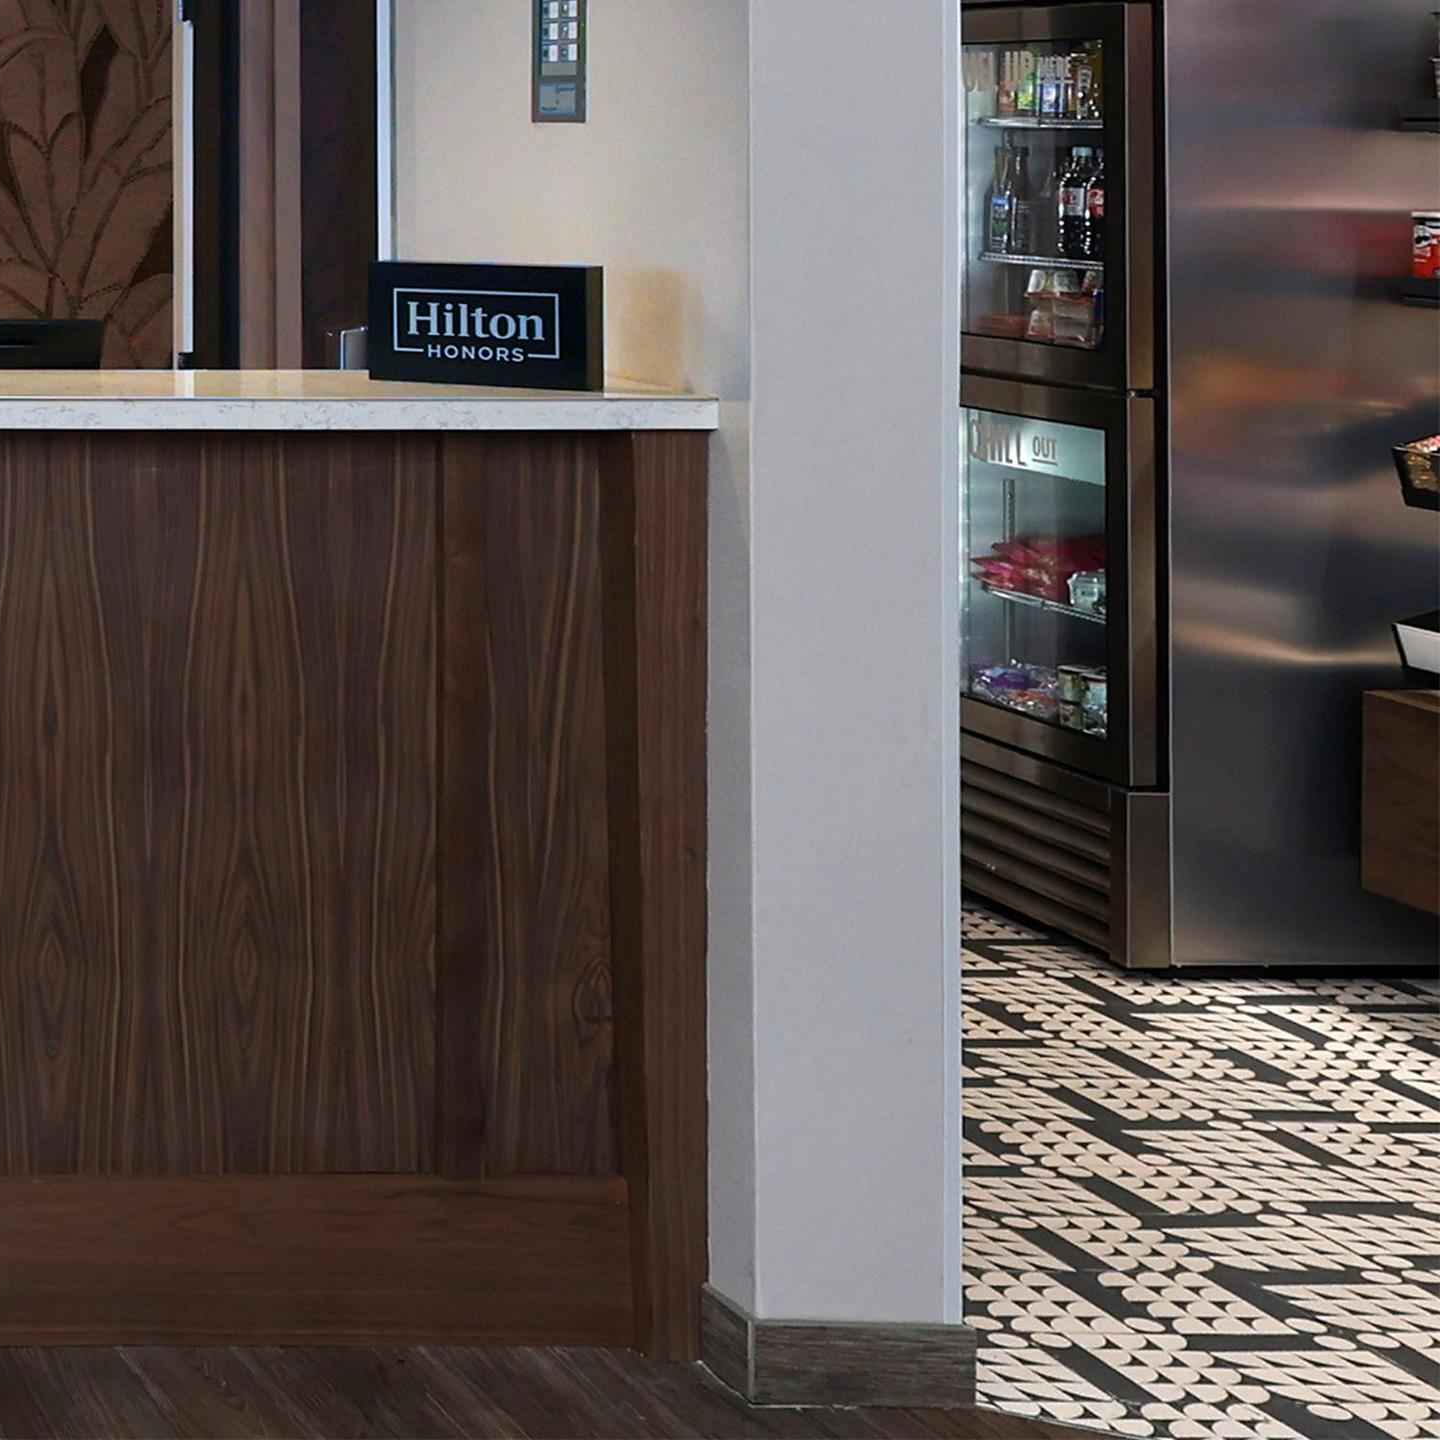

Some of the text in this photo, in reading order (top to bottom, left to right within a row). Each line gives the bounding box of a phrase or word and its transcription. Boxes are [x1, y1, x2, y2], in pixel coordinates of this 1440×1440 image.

[407, 300, 545, 341] Hilton
[427, 343, 525, 362] HONORS
[1032, 435, 1058, 459] OUT
